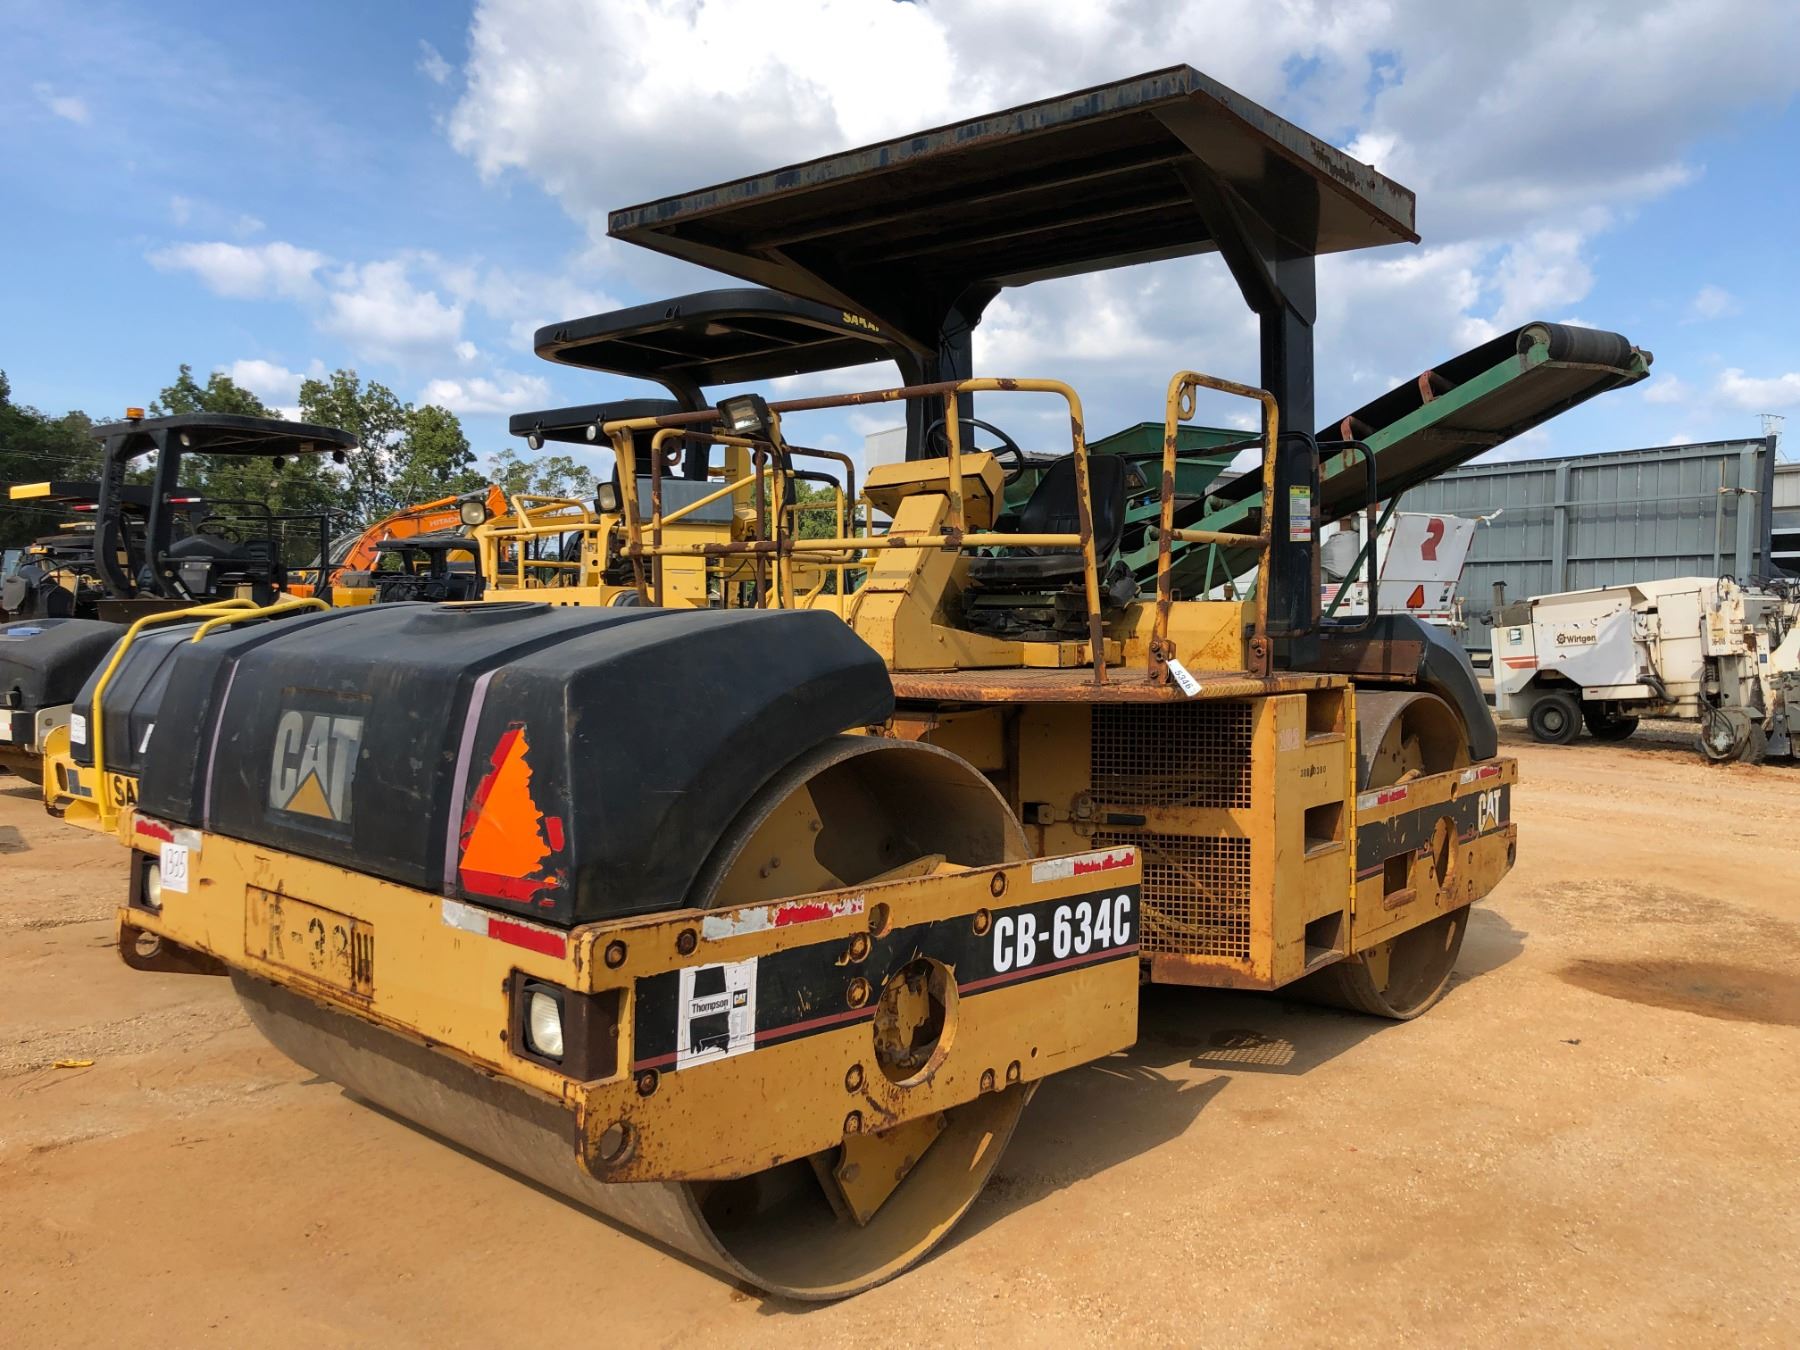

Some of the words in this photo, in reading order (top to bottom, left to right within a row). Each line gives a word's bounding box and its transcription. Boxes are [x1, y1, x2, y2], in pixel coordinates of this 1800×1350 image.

[1566, 634, 1597, 645] Wirtgen
[269, 711, 363, 822] CAT
[113, 775, 140, 807] SA
[1478, 789, 1502, 834] CAT
[993, 894, 1132, 973] CB-634C
[692, 998, 729, 1013] Thompson
[733, 992, 747, 1004] CAT
